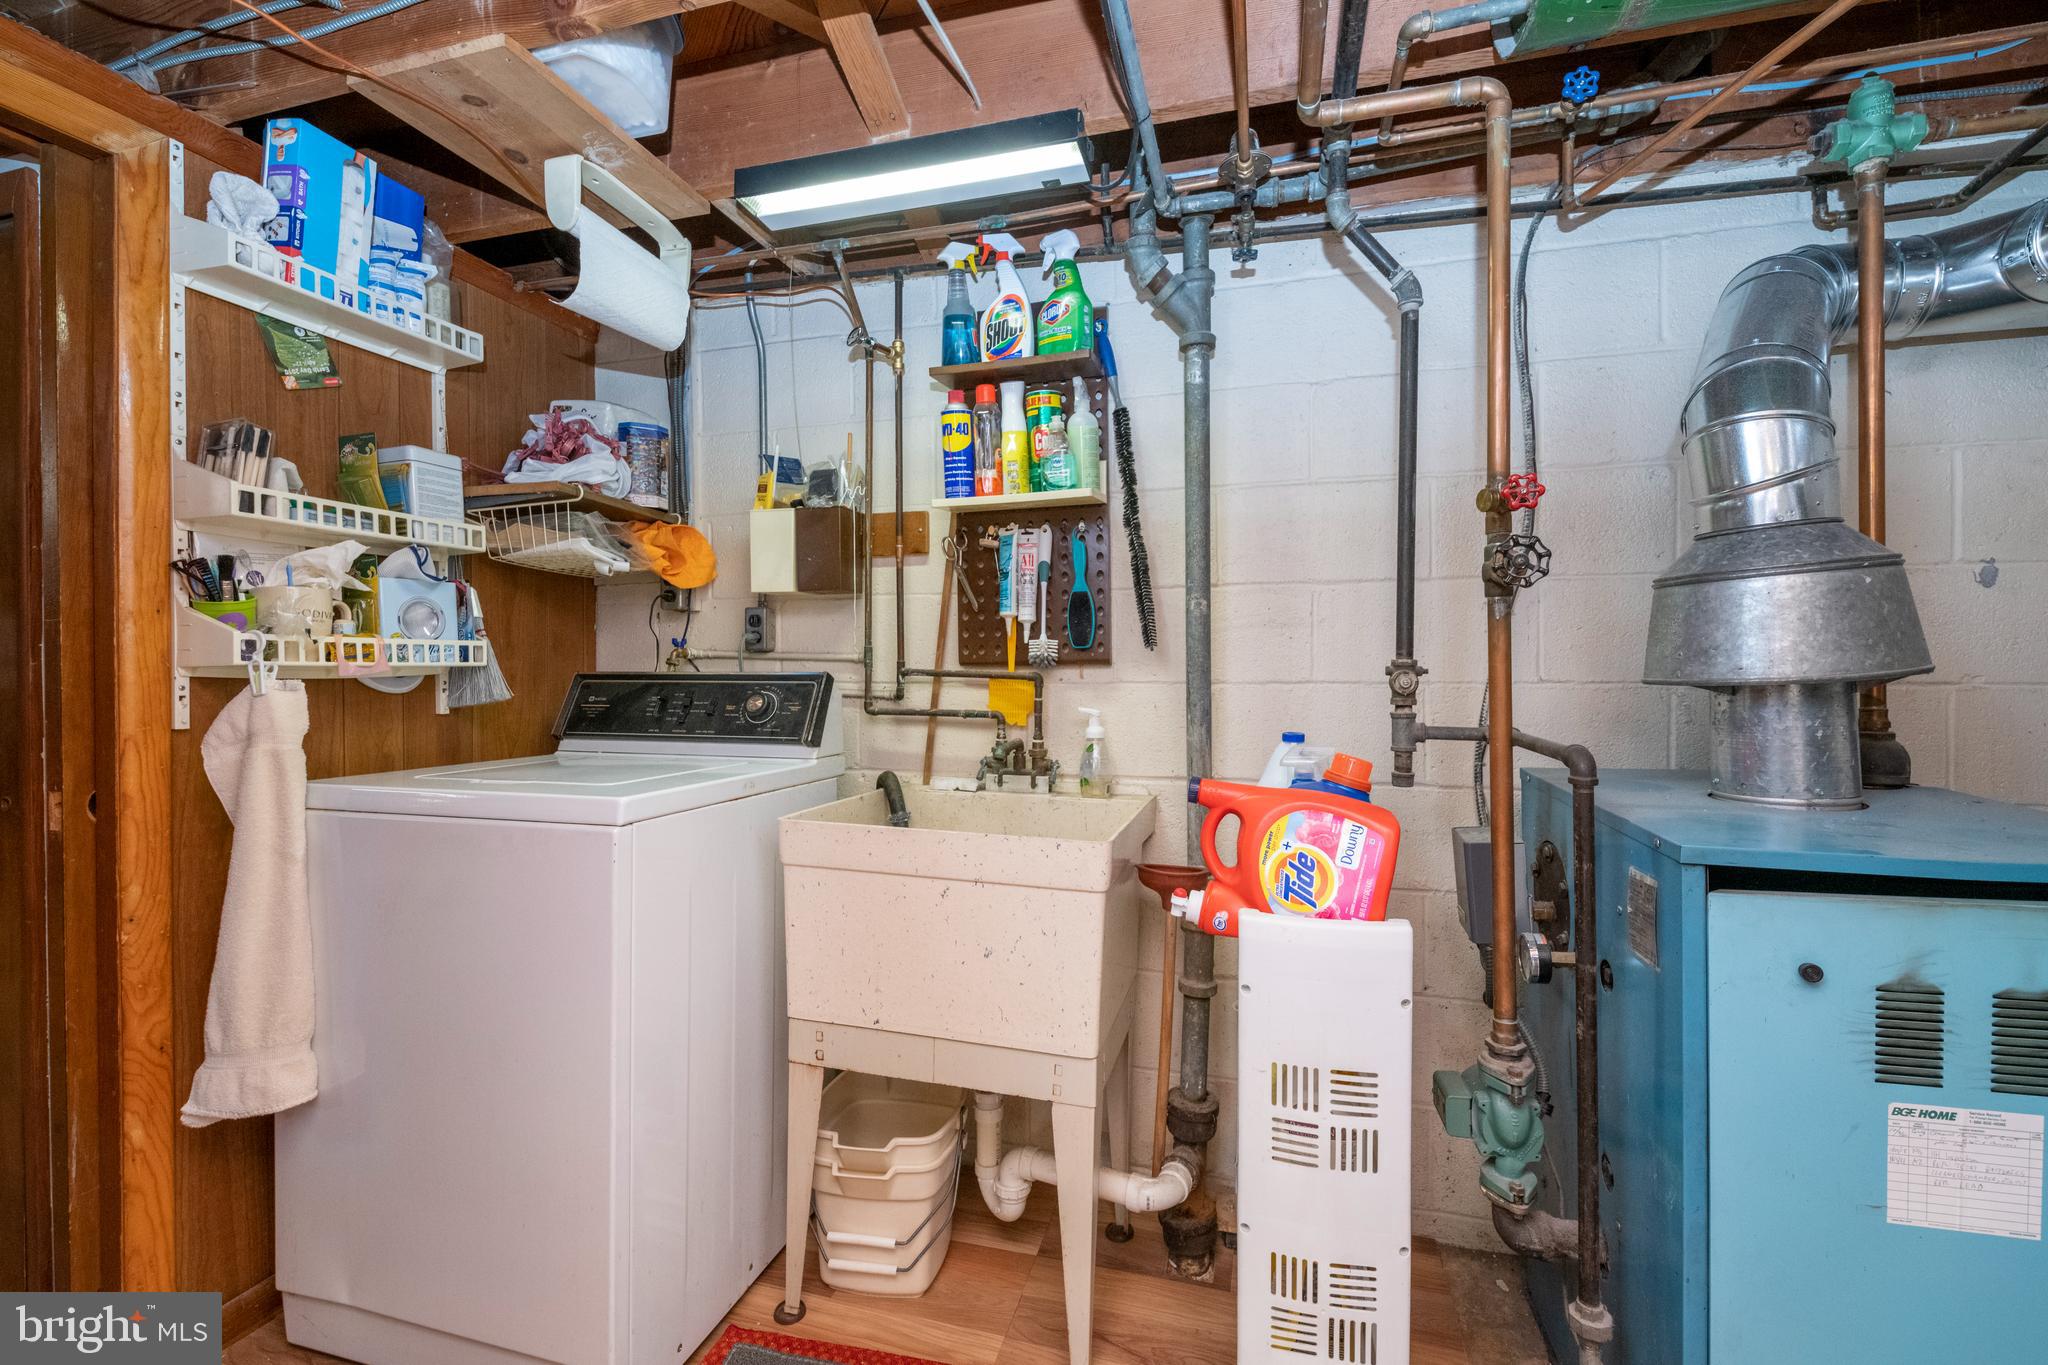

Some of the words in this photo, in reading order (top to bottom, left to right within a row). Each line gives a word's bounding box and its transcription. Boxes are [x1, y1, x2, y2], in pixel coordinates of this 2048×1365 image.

[985, 316, 1024, 353] SHOUT
[1021, 552, 1034, 567] All
[1341, 824, 1365, 865] Downy
[1283, 851, 1317, 909] Tide
[1891, 1107, 1918, 1117] BGE
[1918, 1110, 1957, 1121] HOME
